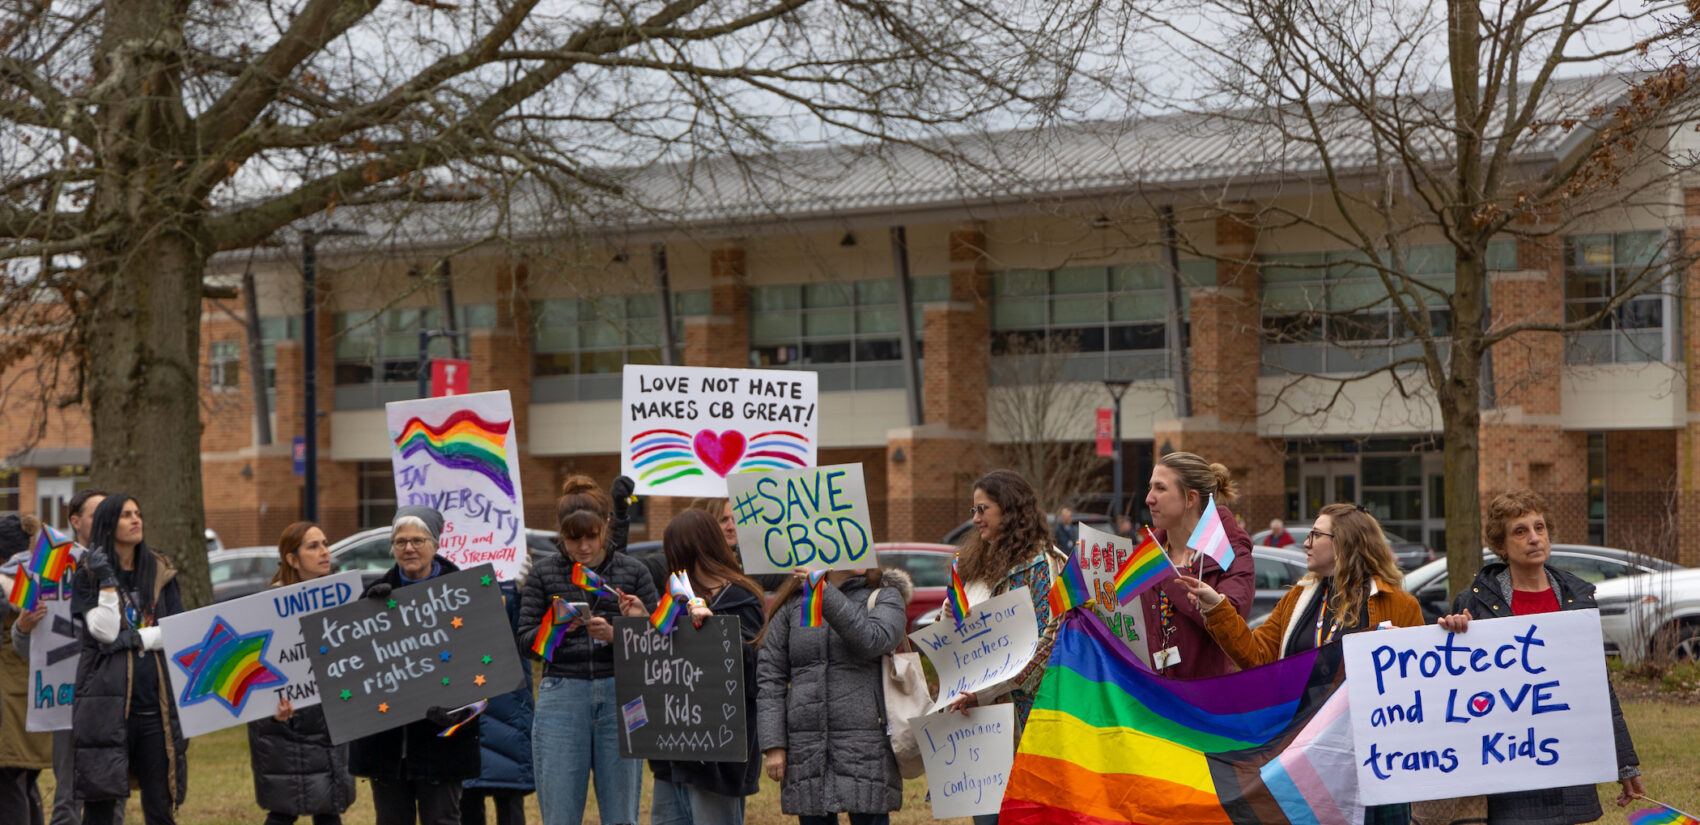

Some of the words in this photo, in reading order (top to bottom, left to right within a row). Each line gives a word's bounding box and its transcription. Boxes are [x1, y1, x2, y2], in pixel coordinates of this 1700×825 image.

[640, 374, 689, 394] LOVE
[701, 377, 740, 394] NOT
[749, 378, 802, 400] HATE
[631, 400, 698, 421] MAKES
[709, 401, 735, 419] CB
[743, 402, 815, 427] GREAT!
[399, 463, 431, 491] IN
[732, 470, 853, 528] #SAVE
[460, 546, 517, 564] STRENGTH
[472, 531, 494, 545] and
[763, 515, 869, 569] CBSD
[321, 616, 392, 648] trans
[398, 584, 471, 628] rights
[921, 633, 953, 651] We
[994, 604, 1019, 623] our
[327, 655, 365, 678] are
[371, 628, 449, 664] human
[362, 656, 436, 695] rights
[644, 658, 704, 692] LGBTQ+
[664, 693, 702, 726] Kids
[1370, 690, 1424, 727] and
[1446, 680, 1571, 724] LOVE
[920, 720, 1002, 766] Ignorance
[1363, 743, 1459, 781] trans
[1482, 727, 1560, 766] Kids
